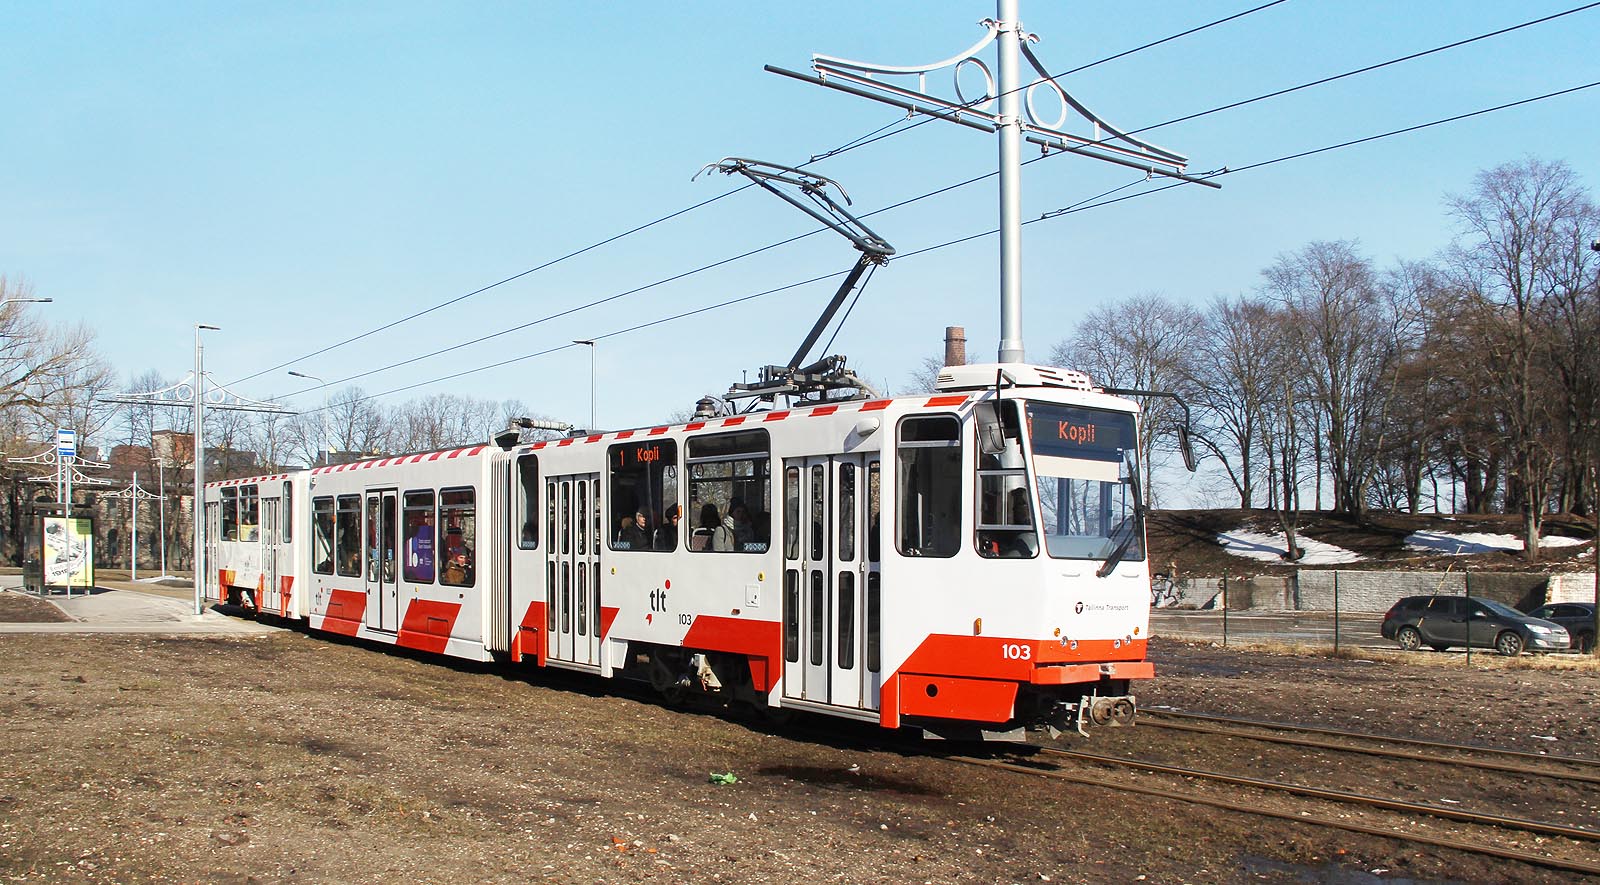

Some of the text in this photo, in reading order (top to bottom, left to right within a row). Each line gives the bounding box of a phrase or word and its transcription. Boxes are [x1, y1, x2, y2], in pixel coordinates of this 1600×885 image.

[1058, 420, 1096, 445] Kopli
[620, 446, 660, 467] 1 Kopli
[649, 588, 666, 612] tlt
[678, 614, 692, 626] 103
[1002, 644, 1031, 660] 103
